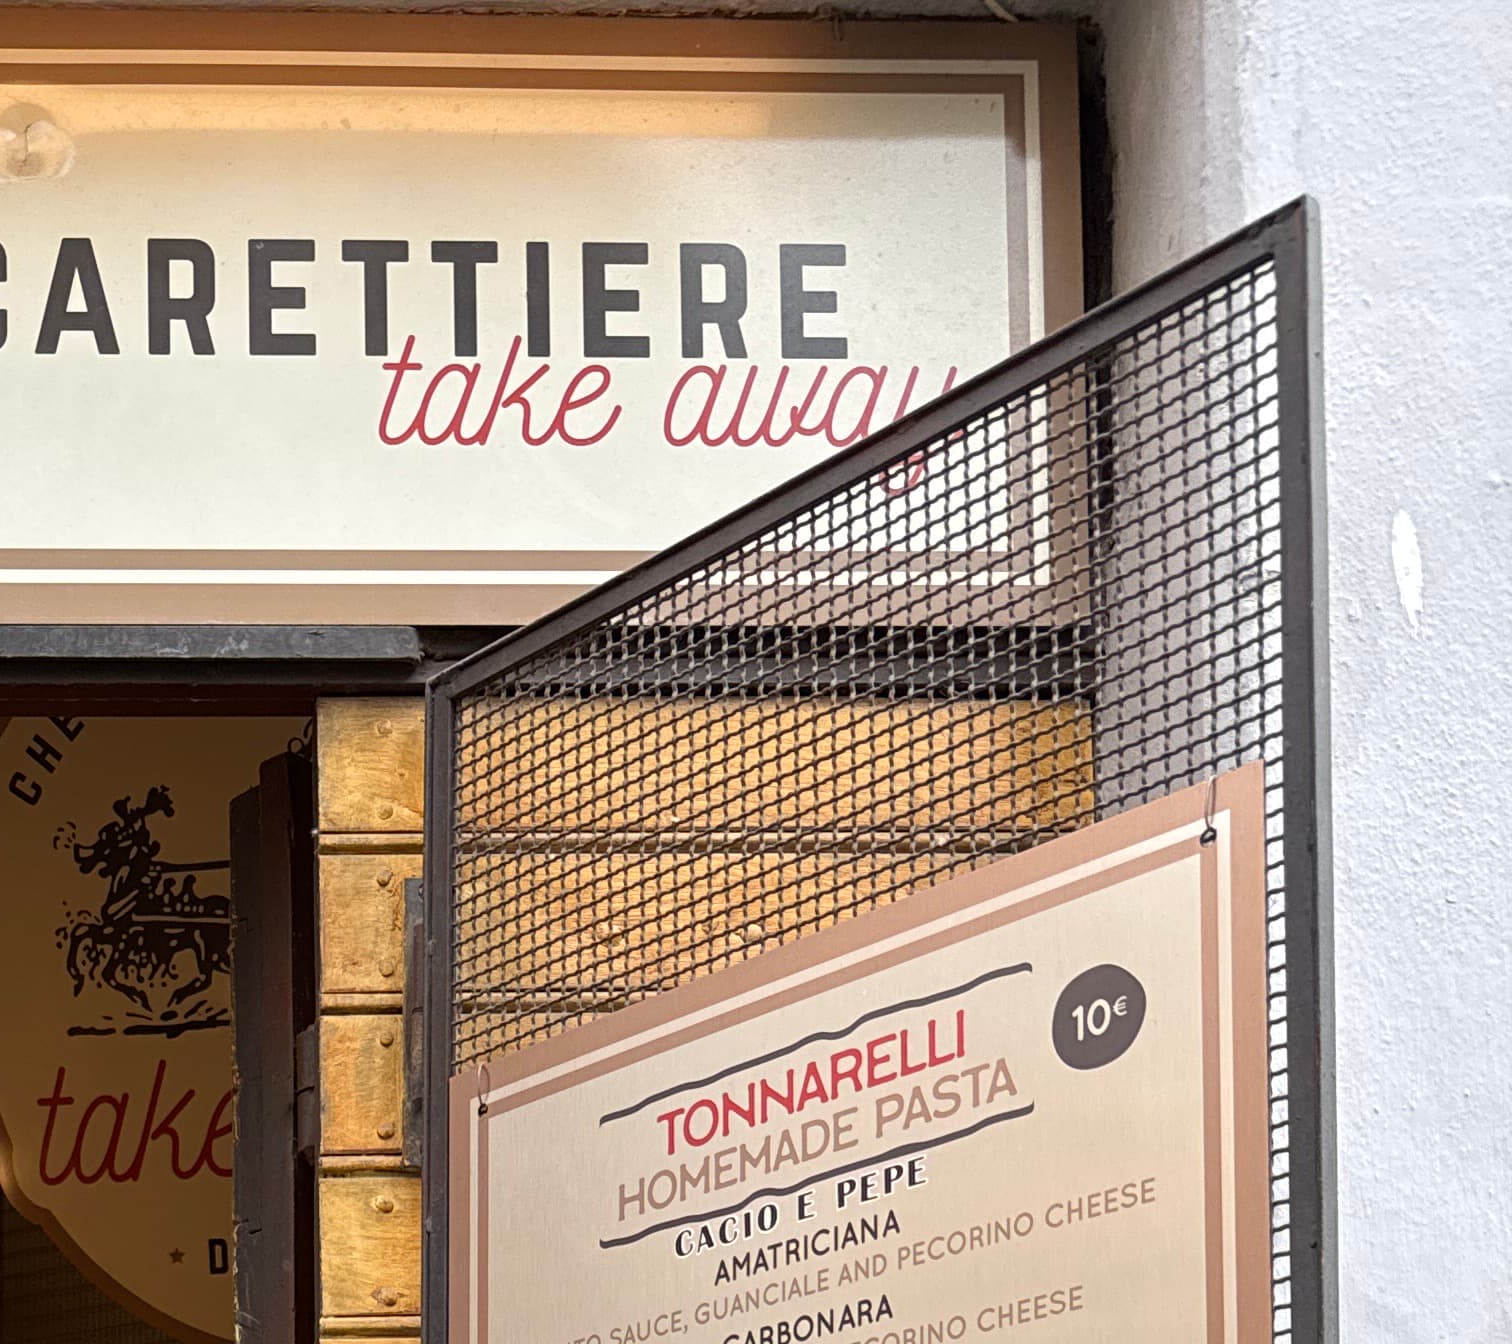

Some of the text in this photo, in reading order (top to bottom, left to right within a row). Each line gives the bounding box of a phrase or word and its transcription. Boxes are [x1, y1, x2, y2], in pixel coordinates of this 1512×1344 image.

[379, 335, 621, 446] take
[619, 1058, 1017, 1221] HOMEMADE PASTA
[657, 1010, 965, 1155] TONNARELLI
[674, 1156, 929, 1258] CACIO E PEPE
[694, 1268, 829, 1325] GUANCIALE
[838, 1253, 887, 1286] AND
[898, 1212, 1034, 1270] PECORINO
[1045, 1177, 1155, 1228] CHEESE
[714, 1210, 900, 1286] AMATRICIANA
